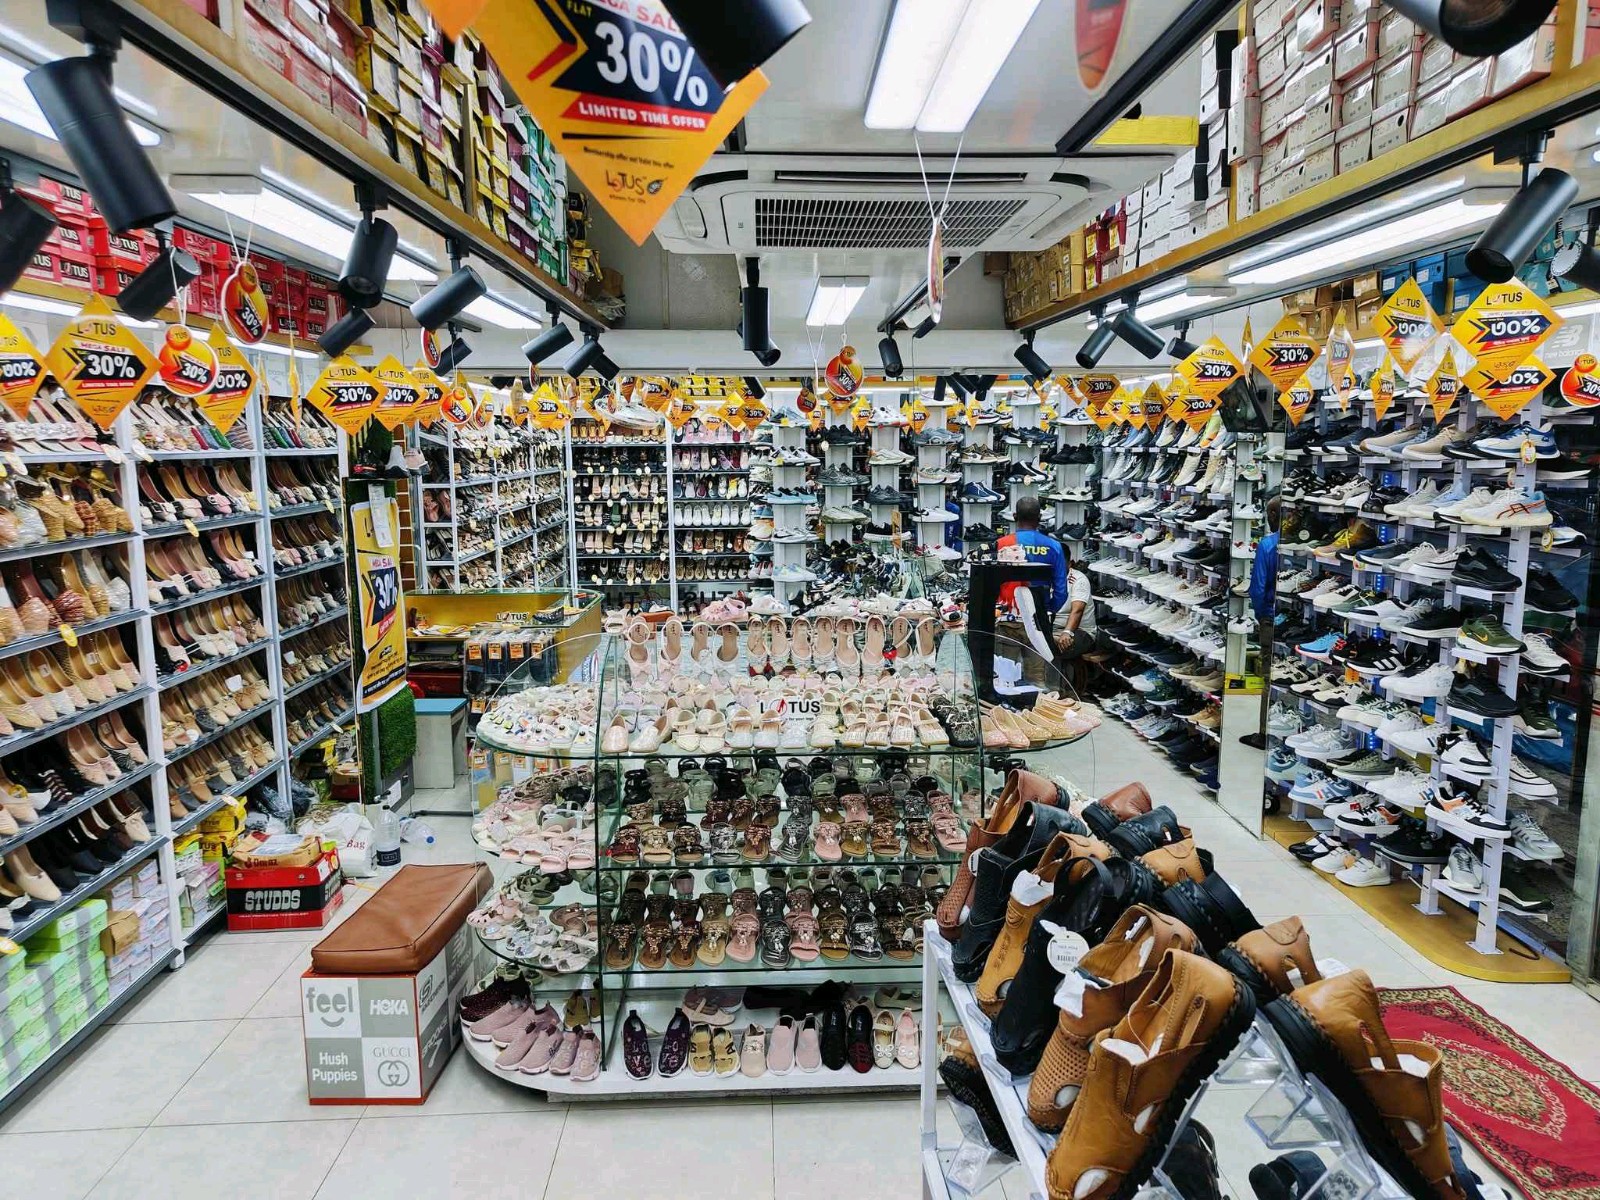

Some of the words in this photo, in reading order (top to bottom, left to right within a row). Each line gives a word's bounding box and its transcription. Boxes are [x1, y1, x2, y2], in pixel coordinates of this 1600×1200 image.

[566, 0, 592, 18] FLAT
[637, 5, 677, 32] SAL
[595, 21, 708, 107] 30%
[578, 102, 637, 121] LIMITED
[640, 111, 669, 125] TIME
[672, 115, 706, 129] OFFER
[63, 186, 82, 199] TUS
[60, 227, 79, 240] TUS
[109, 233, 140, 251] LOTUS
[33, 254, 52, 267] TUS
[60, 262, 89, 278] LOTUS
[1486, 291, 1523, 306] LOTUS
[77, 322, 117, 336] LOTUS
[241, 307, 259, 337] 30%
[218, 347, 232, 357] TUS
[1280, 348, 1309, 362] 30%
[88, 354, 136, 378] 30%
[182, 363, 208, 384] 30%
[329, 368, 357, 378] LOTUS
[1204, 364, 1231, 377] 30%
[840, 373, 852, 390] 30%
[1094, 382, 1112, 391] 30%
[338, 387, 372, 403] 30%
[384, 387, 414, 403] 30%
[1295, 391, 1309, 404] 30%
[542, 402, 557, 412] 30%
[1025, 545, 1048, 555] TUS
[497, 613, 528, 621] LOTUS
[760, 698, 821, 716] LOTUS
[346, 838, 366, 850] Bag
[245, 889, 301, 911] STUDDS
[306, 987, 354, 1013] feel
[369, 999, 409, 1015] HOKA
[319, 1052, 348, 1065] Hush
[373, 1047, 412, 1058] GUCCI
[312, 1068, 358, 1085] Puppies
